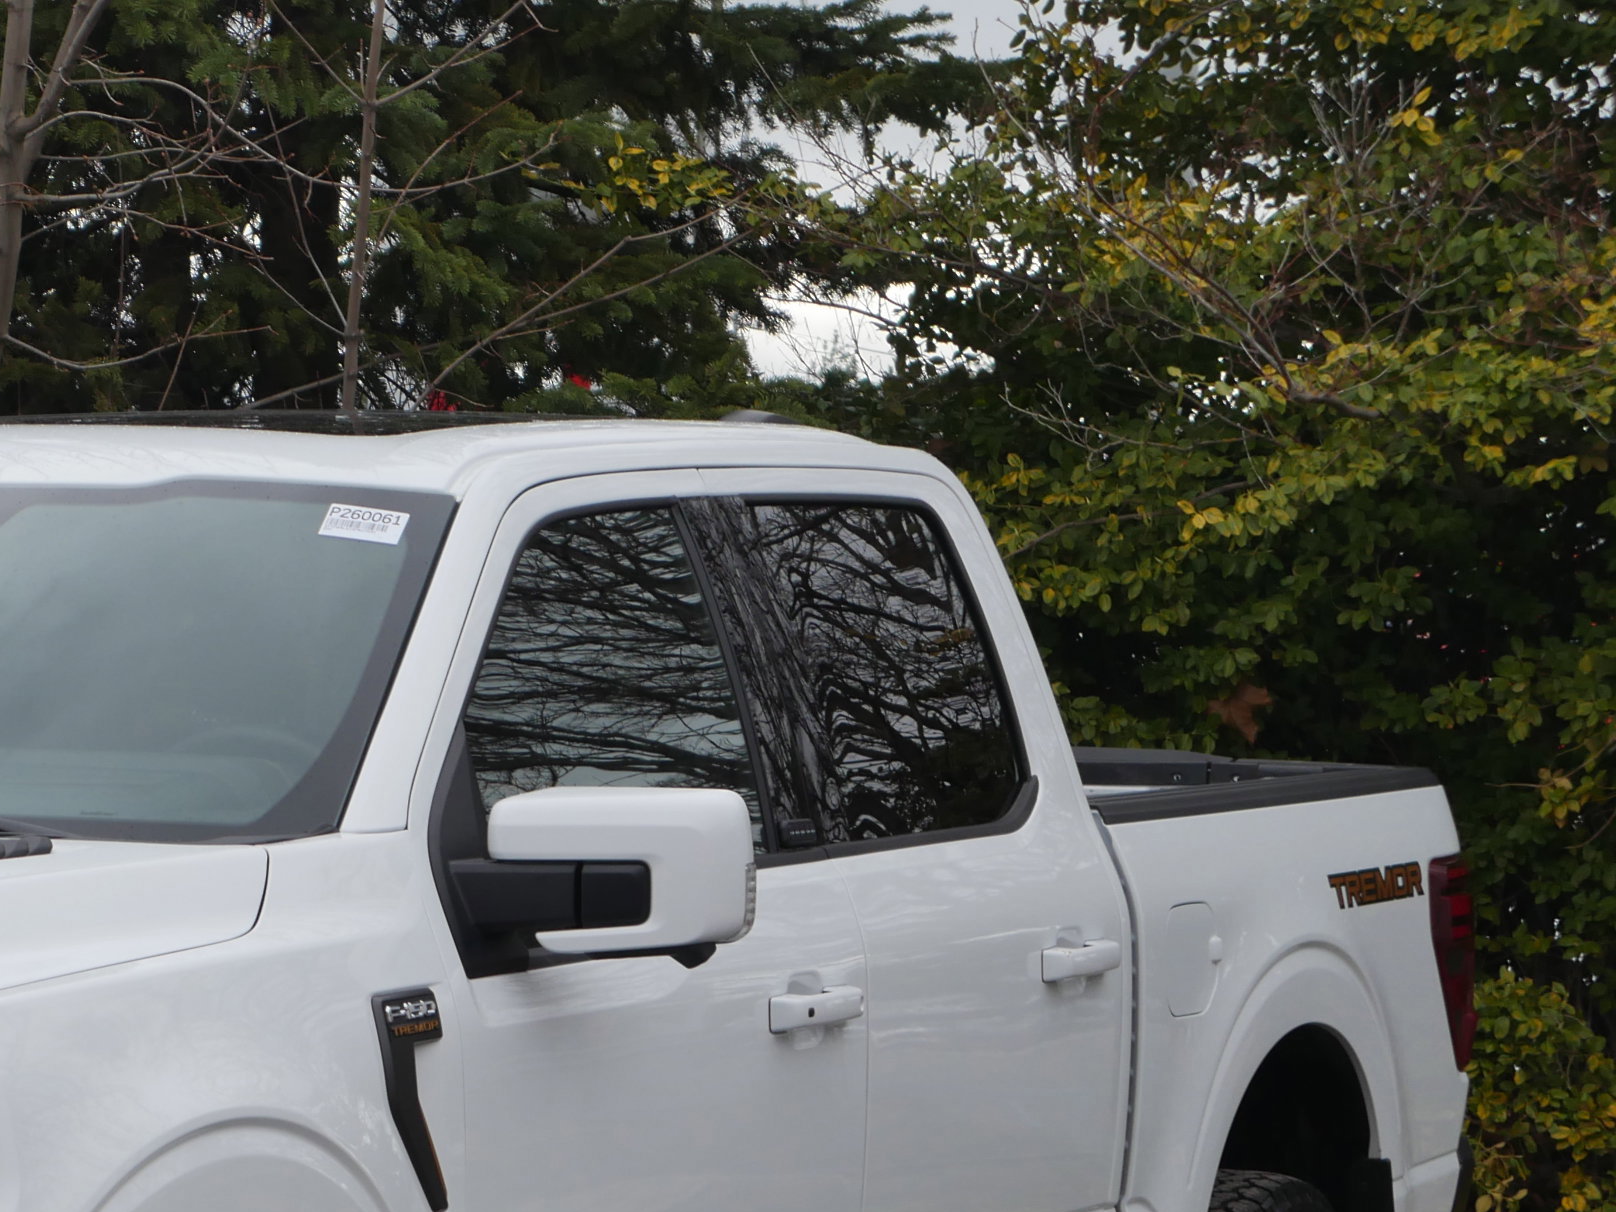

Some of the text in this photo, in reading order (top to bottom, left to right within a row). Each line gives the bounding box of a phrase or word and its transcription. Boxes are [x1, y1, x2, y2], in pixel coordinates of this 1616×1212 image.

[329, 506, 401, 526] P260061
[1327, 861, 1424, 909] TREMOR
[385, 999, 437, 1022] F-150
[392, 1021, 438, 1036] TREMOR
